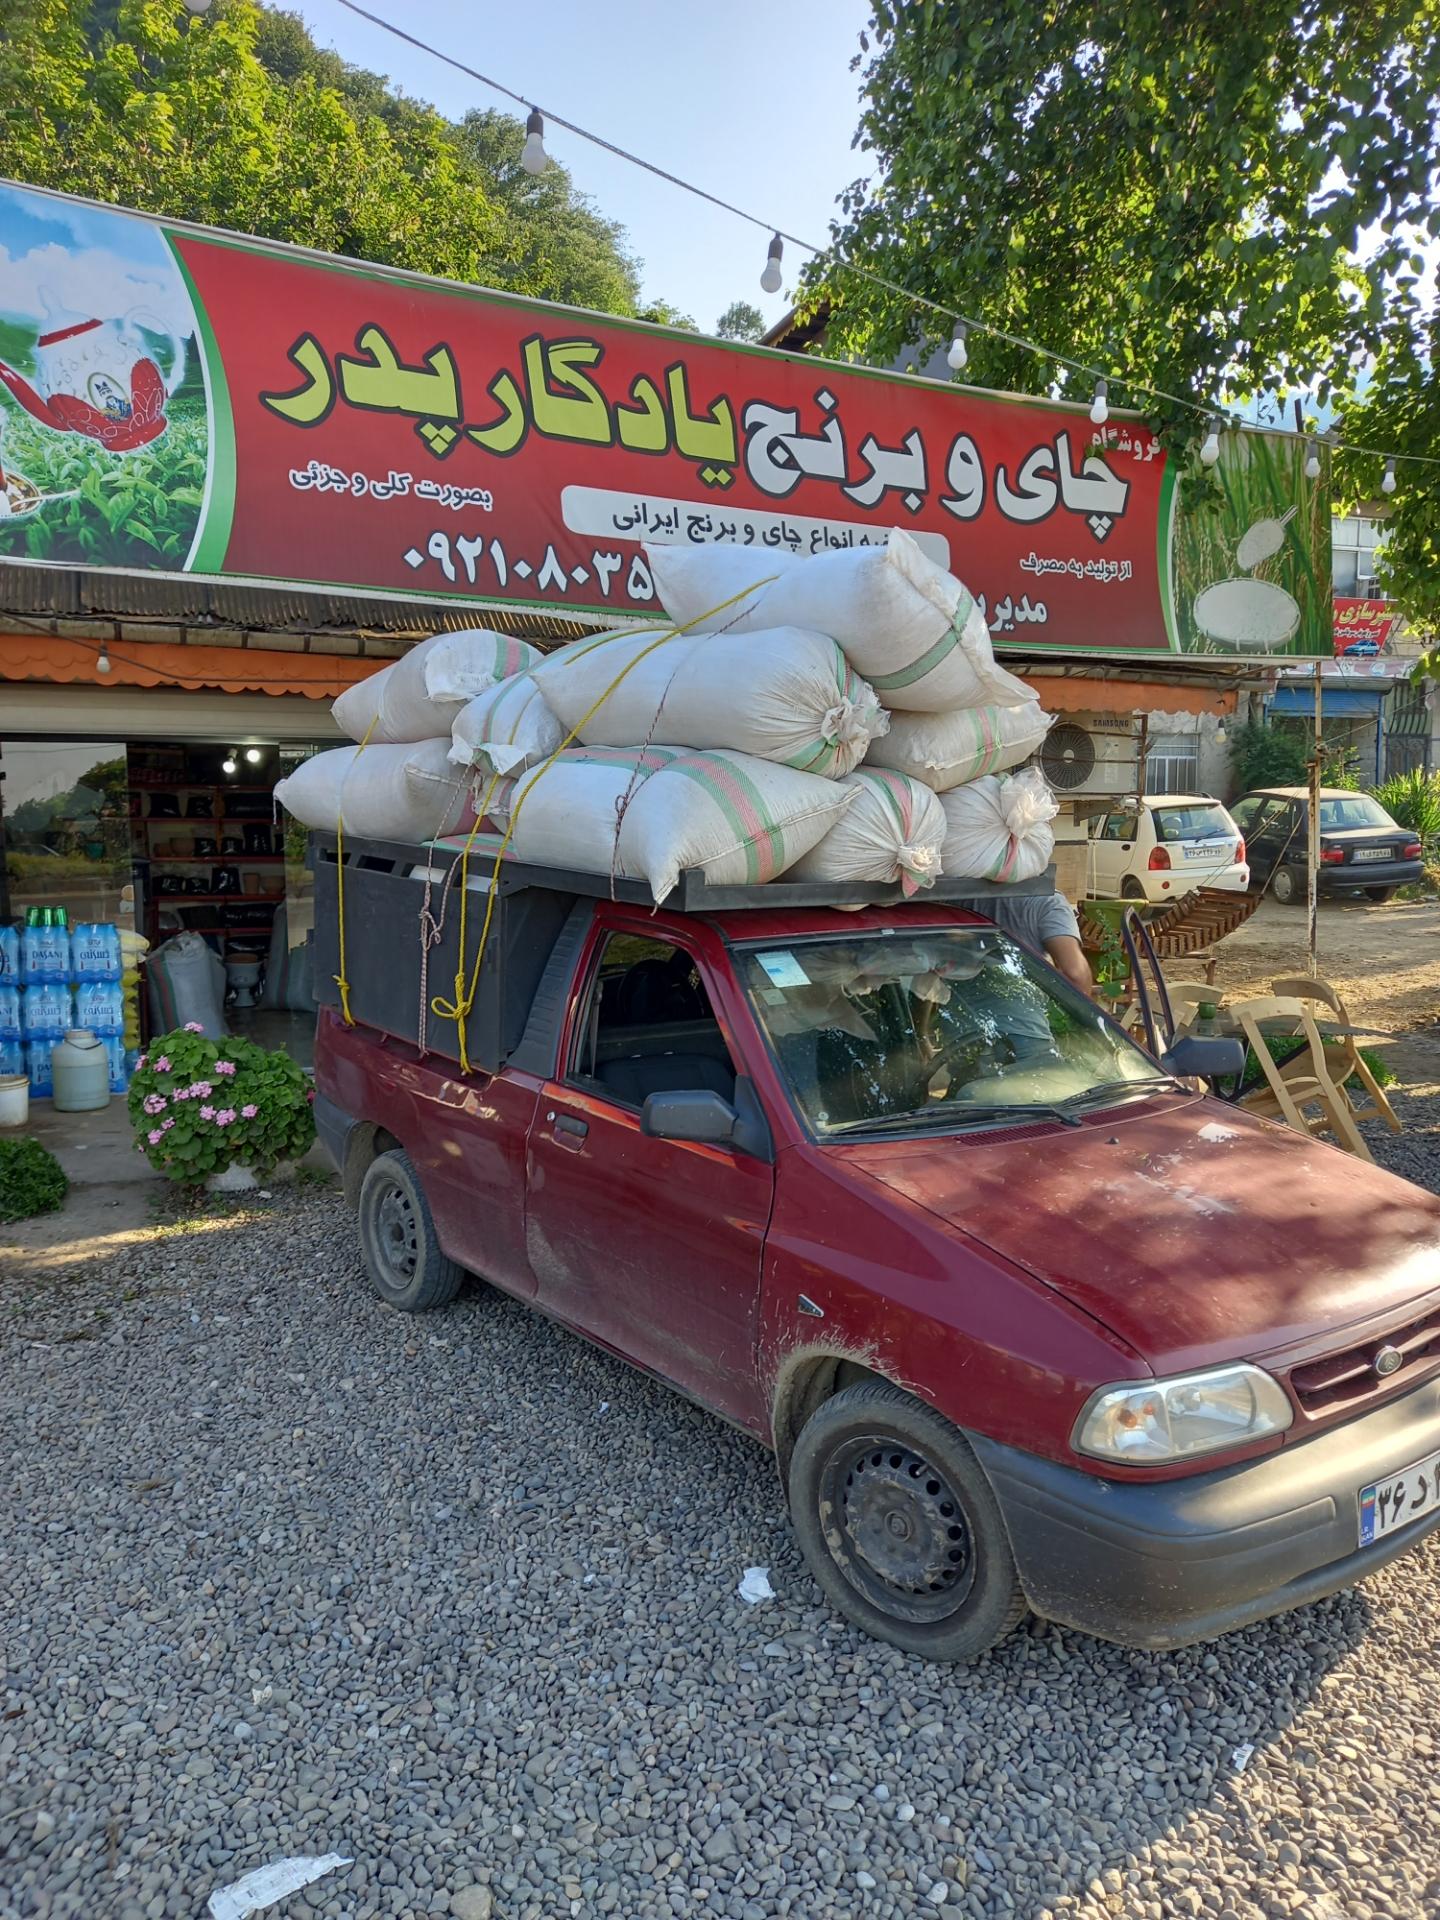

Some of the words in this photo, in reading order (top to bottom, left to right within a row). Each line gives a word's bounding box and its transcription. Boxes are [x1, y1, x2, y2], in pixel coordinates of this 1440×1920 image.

[260, 324, 461, 458] پدر
[464, 335, 739, 488] یادگار
[743, 388, 929, 512] برنج
[1092, 426, 1161, 462] فروشگاه
[290, 461, 349, 492] جزئی
[352, 473, 368, 495] و
[372, 472, 412, 498] کلی
[939, 432, 986, 520] و
[994, 430, 1130, 542] چای
[415, 481, 492, 511] بصورت
[612, 502, 680, 535] ایرانی
[686, 513, 737, 543] برنج
[744, 523, 754, 543] و
[763, 521, 801, 551] چای
[1020, 552, 1067, 576] مصرف
[1067, 558, 1084, 578] به
[1085, 559, 1118, 582] تولید
[1119, 561, 1132, 581] از
[32, 950, 62, 960] DASANI
